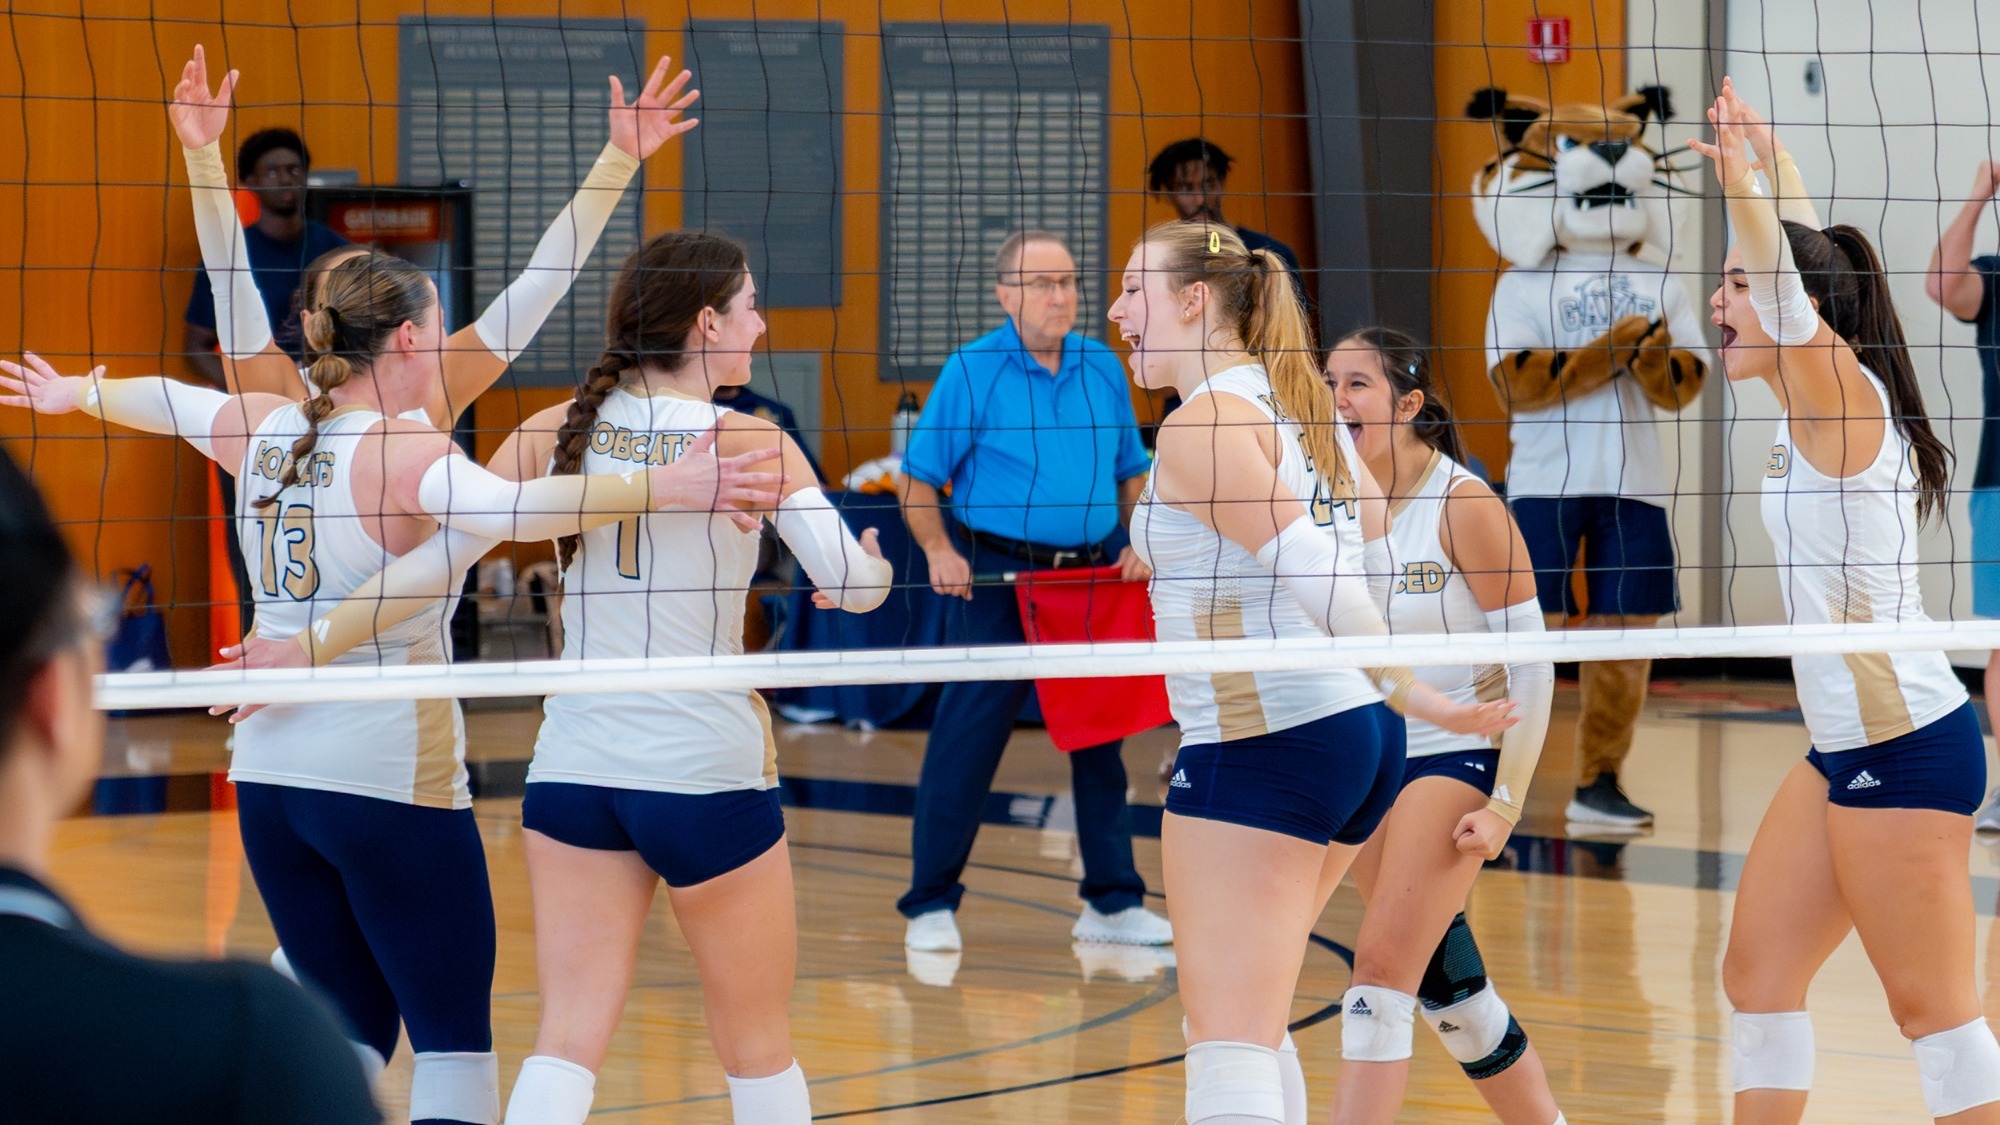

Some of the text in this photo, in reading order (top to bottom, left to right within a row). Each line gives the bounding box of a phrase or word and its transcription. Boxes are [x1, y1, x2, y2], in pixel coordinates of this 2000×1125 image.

[590, 421, 698, 465] OBCATS
[256, 495, 320, 602] 13
[1847, 779, 1881, 790] adidas
